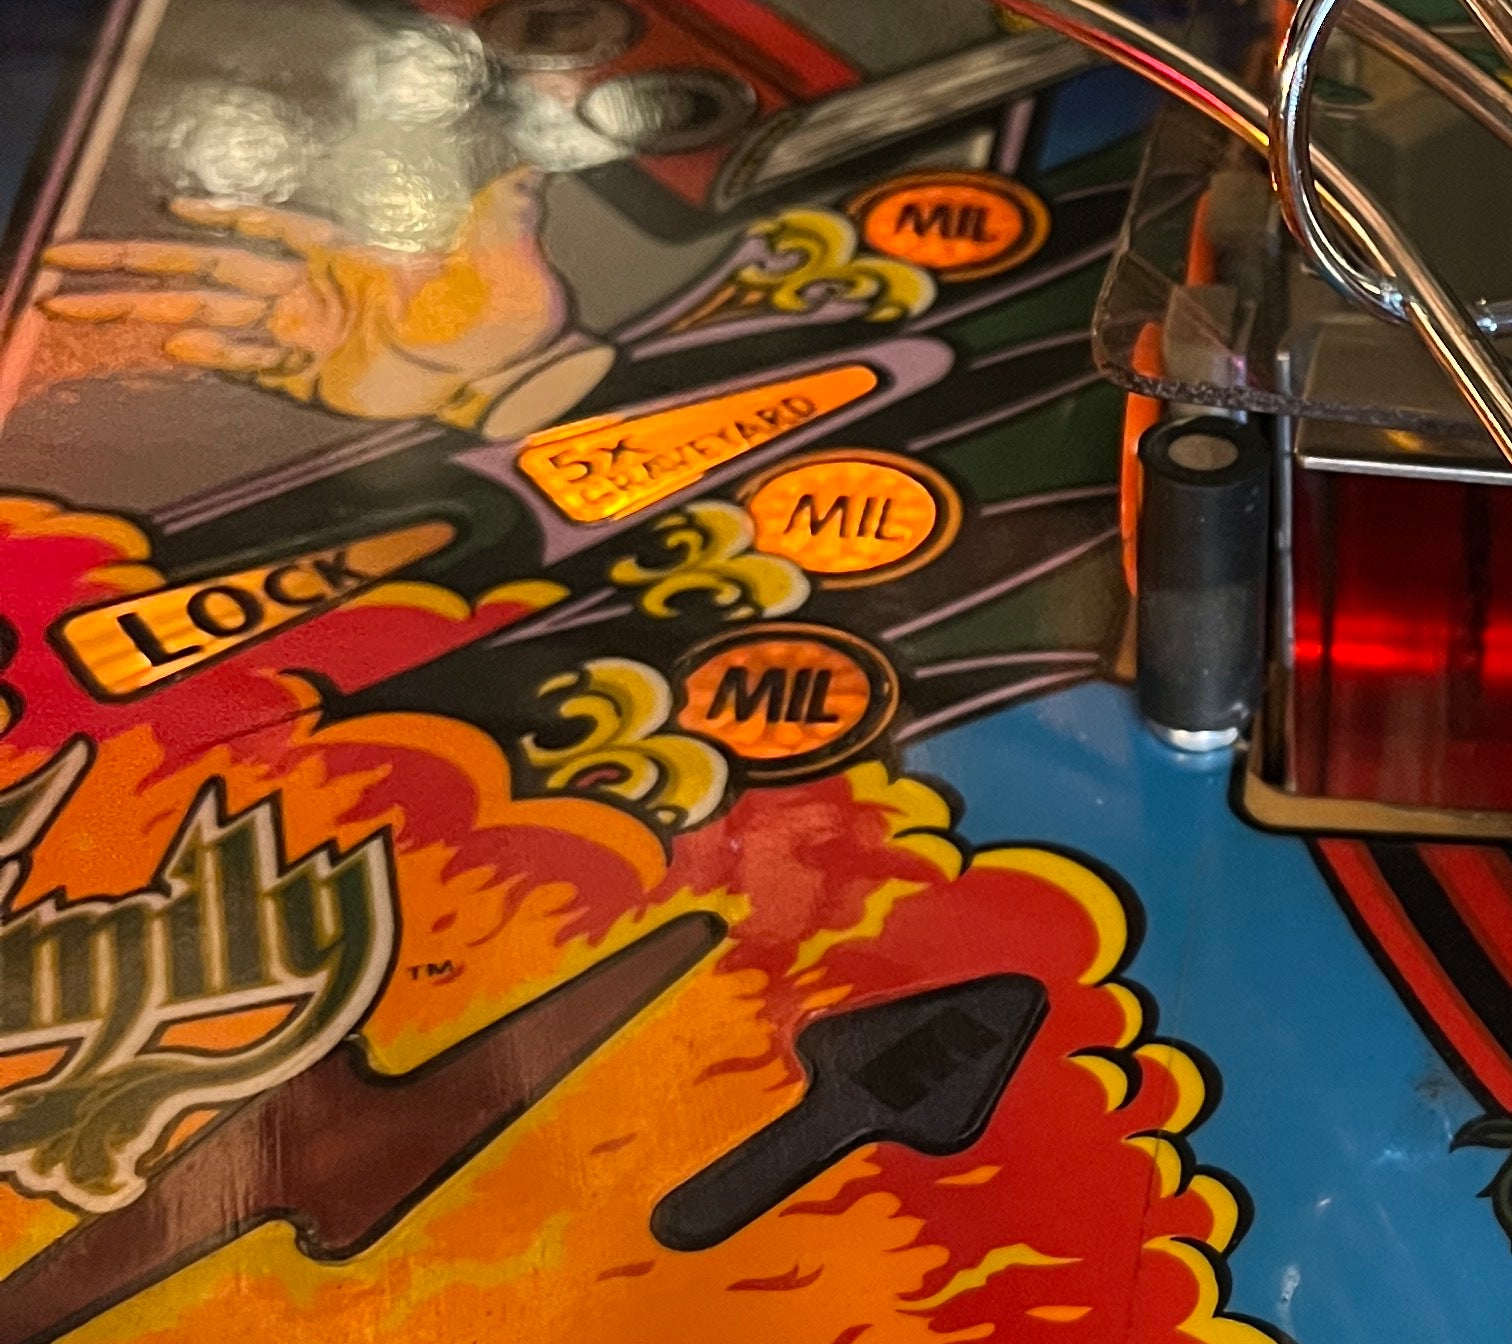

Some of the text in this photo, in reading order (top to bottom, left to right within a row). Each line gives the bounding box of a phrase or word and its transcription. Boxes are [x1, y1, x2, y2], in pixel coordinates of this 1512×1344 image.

[893, 202, 999, 243] MIL
[547, 436, 649, 484] 5X
[783, 493, 906, 541] MIL
[116, 551, 379, 668] LOCK
[706, 665, 840, 724] MIL
[408, 960, 456, 983] TM
